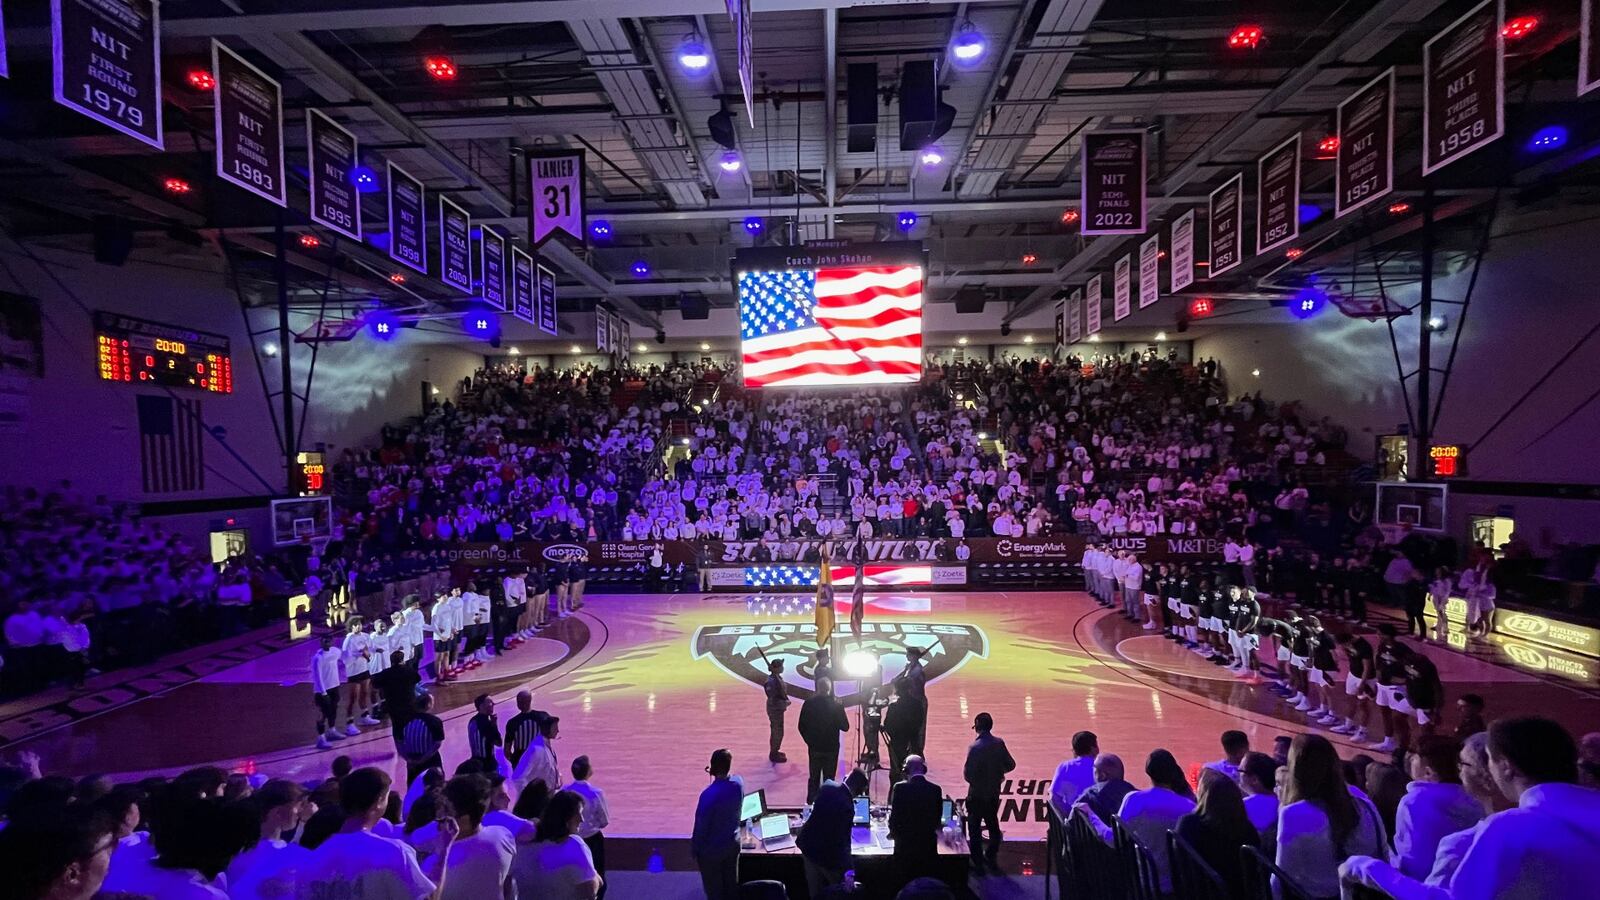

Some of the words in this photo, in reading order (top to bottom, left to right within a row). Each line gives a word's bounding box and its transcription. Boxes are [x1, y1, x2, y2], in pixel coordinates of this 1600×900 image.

[91, 26, 131, 61] NIT
[90, 52, 133, 82] FIRST
[87, 64, 137, 99] ROUND
[1448, 69, 1476, 98] NIT
[83, 84, 143, 127] 1979
[238, 111, 264, 137] NIT
[1444, 103, 1479, 130] PLACE
[239, 133, 265, 155] FIRST
[1353, 132, 1374, 155] NIT
[1439, 119, 1485, 156] 1958
[237, 143, 268, 167] ROUND
[234, 159, 273, 190] 1983
[325, 163, 344, 183] NIT
[537, 159, 573, 179] LANIER
[1102, 174, 1126, 185] NIT
[1346, 175, 1378, 203] 1957
[543, 184, 571, 218] 31
[1269, 185, 1287, 203] NIT
[323, 204, 351, 228] 1995
[401, 209, 415, 225] NIT
[1096, 213, 1133, 226] 2022
[447, 232, 466, 249] NCAA
[1264, 223, 1288, 243] 1952
[398, 244, 419, 263] 1998
[816, 241, 837, 249] Memory
[786, 256, 812, 265] Coach
[816, 255, 836, 264] John
[840, 254, 872, 263] Skehan
[1215, 251, 1233, 268] 1951
[448, 268, 467, 285] 2000
[156, 338, 186, 355] 20:00
[1430, 447, 1458, 458] 20:00
[303, 464, 324, 474] 20:00
[1434, 457, 1456, 475] 30
[307, 474, 322, 489] 30
[618, 551, 645, 559] Hospital
[1013, 542, 1066, 553] EnergyMark
